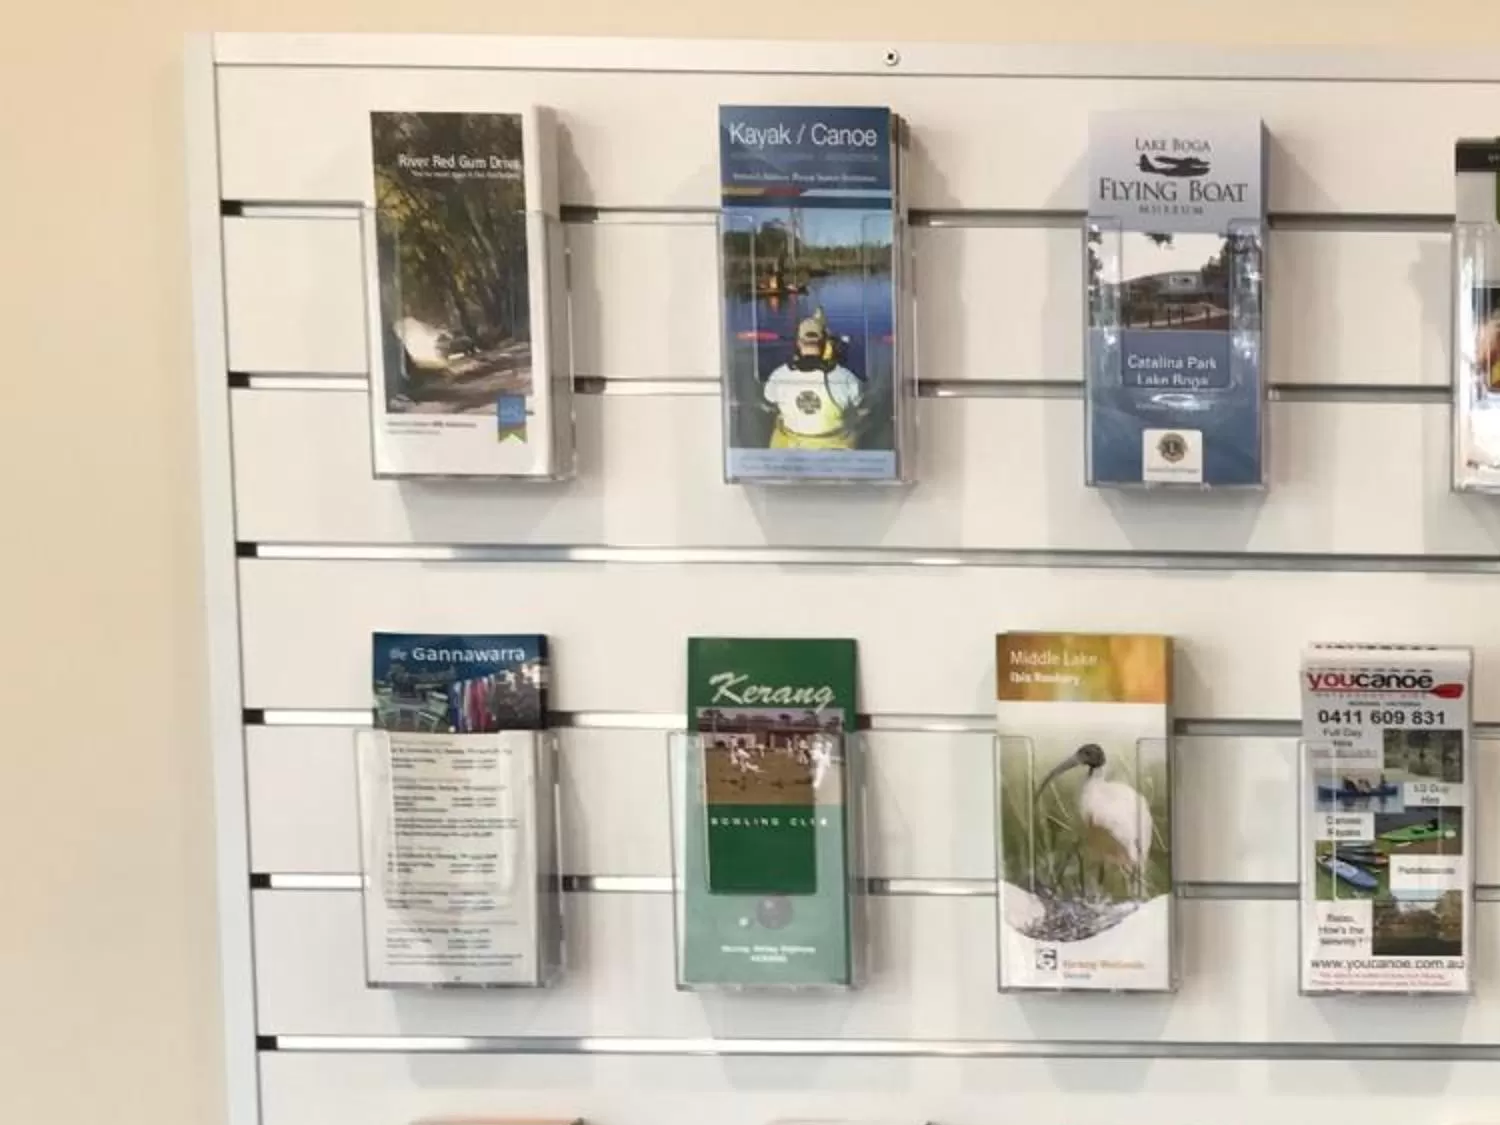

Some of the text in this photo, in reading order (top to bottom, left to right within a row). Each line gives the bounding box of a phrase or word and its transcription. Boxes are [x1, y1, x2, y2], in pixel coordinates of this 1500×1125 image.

[729, 122, 792, 149] Kayak
[811, 123, 878, 147] Canoe
[1136, 137, 1166, 151] LAKE
[398, 153, 430, 169] River
[432, 154, 455, 169] Red
[459, 154, 487, 169] Gum
[1100, 177, 1248, 202] FLYING BOAT
[1128, 354, 1216, 369] Catalina Park
[1137, 373, 1169, 385] Lake
[412, 646, 525, 663] Gannawarra
[1010, 651, 1097, 667] Middle Lake
[1307, 672, 1433, 689] youcanoe
[709, 671, 836, 713] Kerang
[1318, 710, 1445, 725] 0411 609 831
